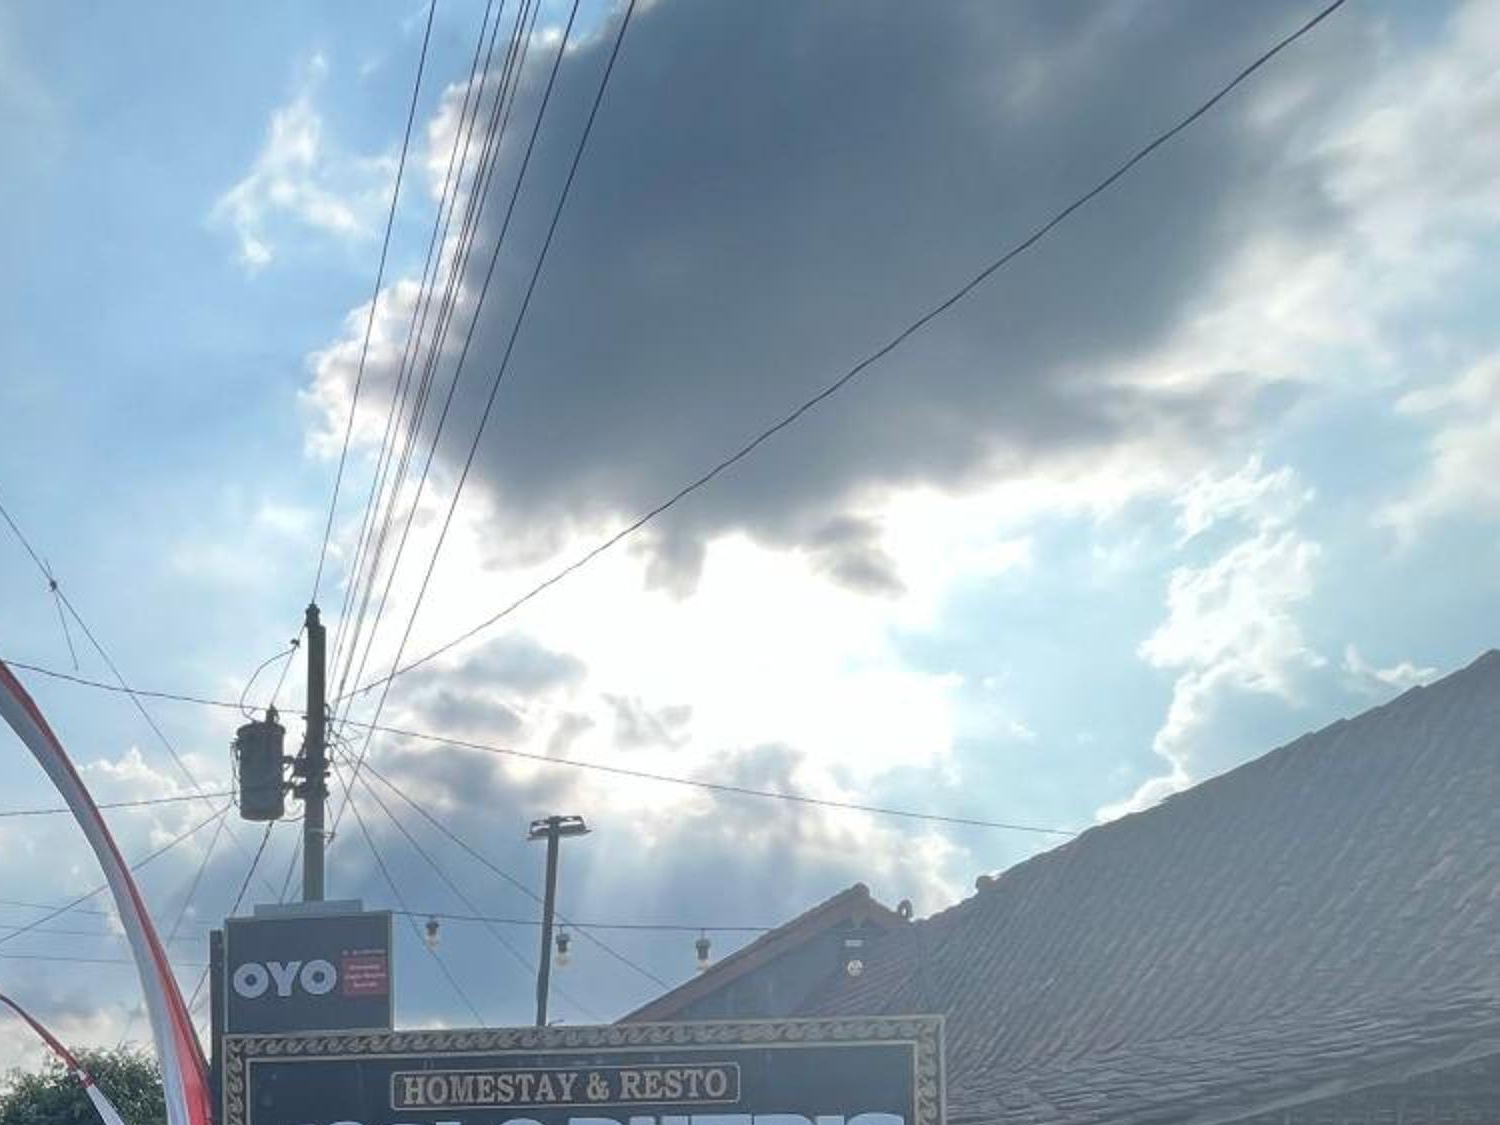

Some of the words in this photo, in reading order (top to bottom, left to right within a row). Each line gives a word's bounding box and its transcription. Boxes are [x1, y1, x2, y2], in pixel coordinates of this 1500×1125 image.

[233, 959, 337, 998] OYO
[403, 1073, 580, 1105] HOMESTAY
[586, 1072, 609, 1101] &
[619, 1069, 728, 1100] RESTO
